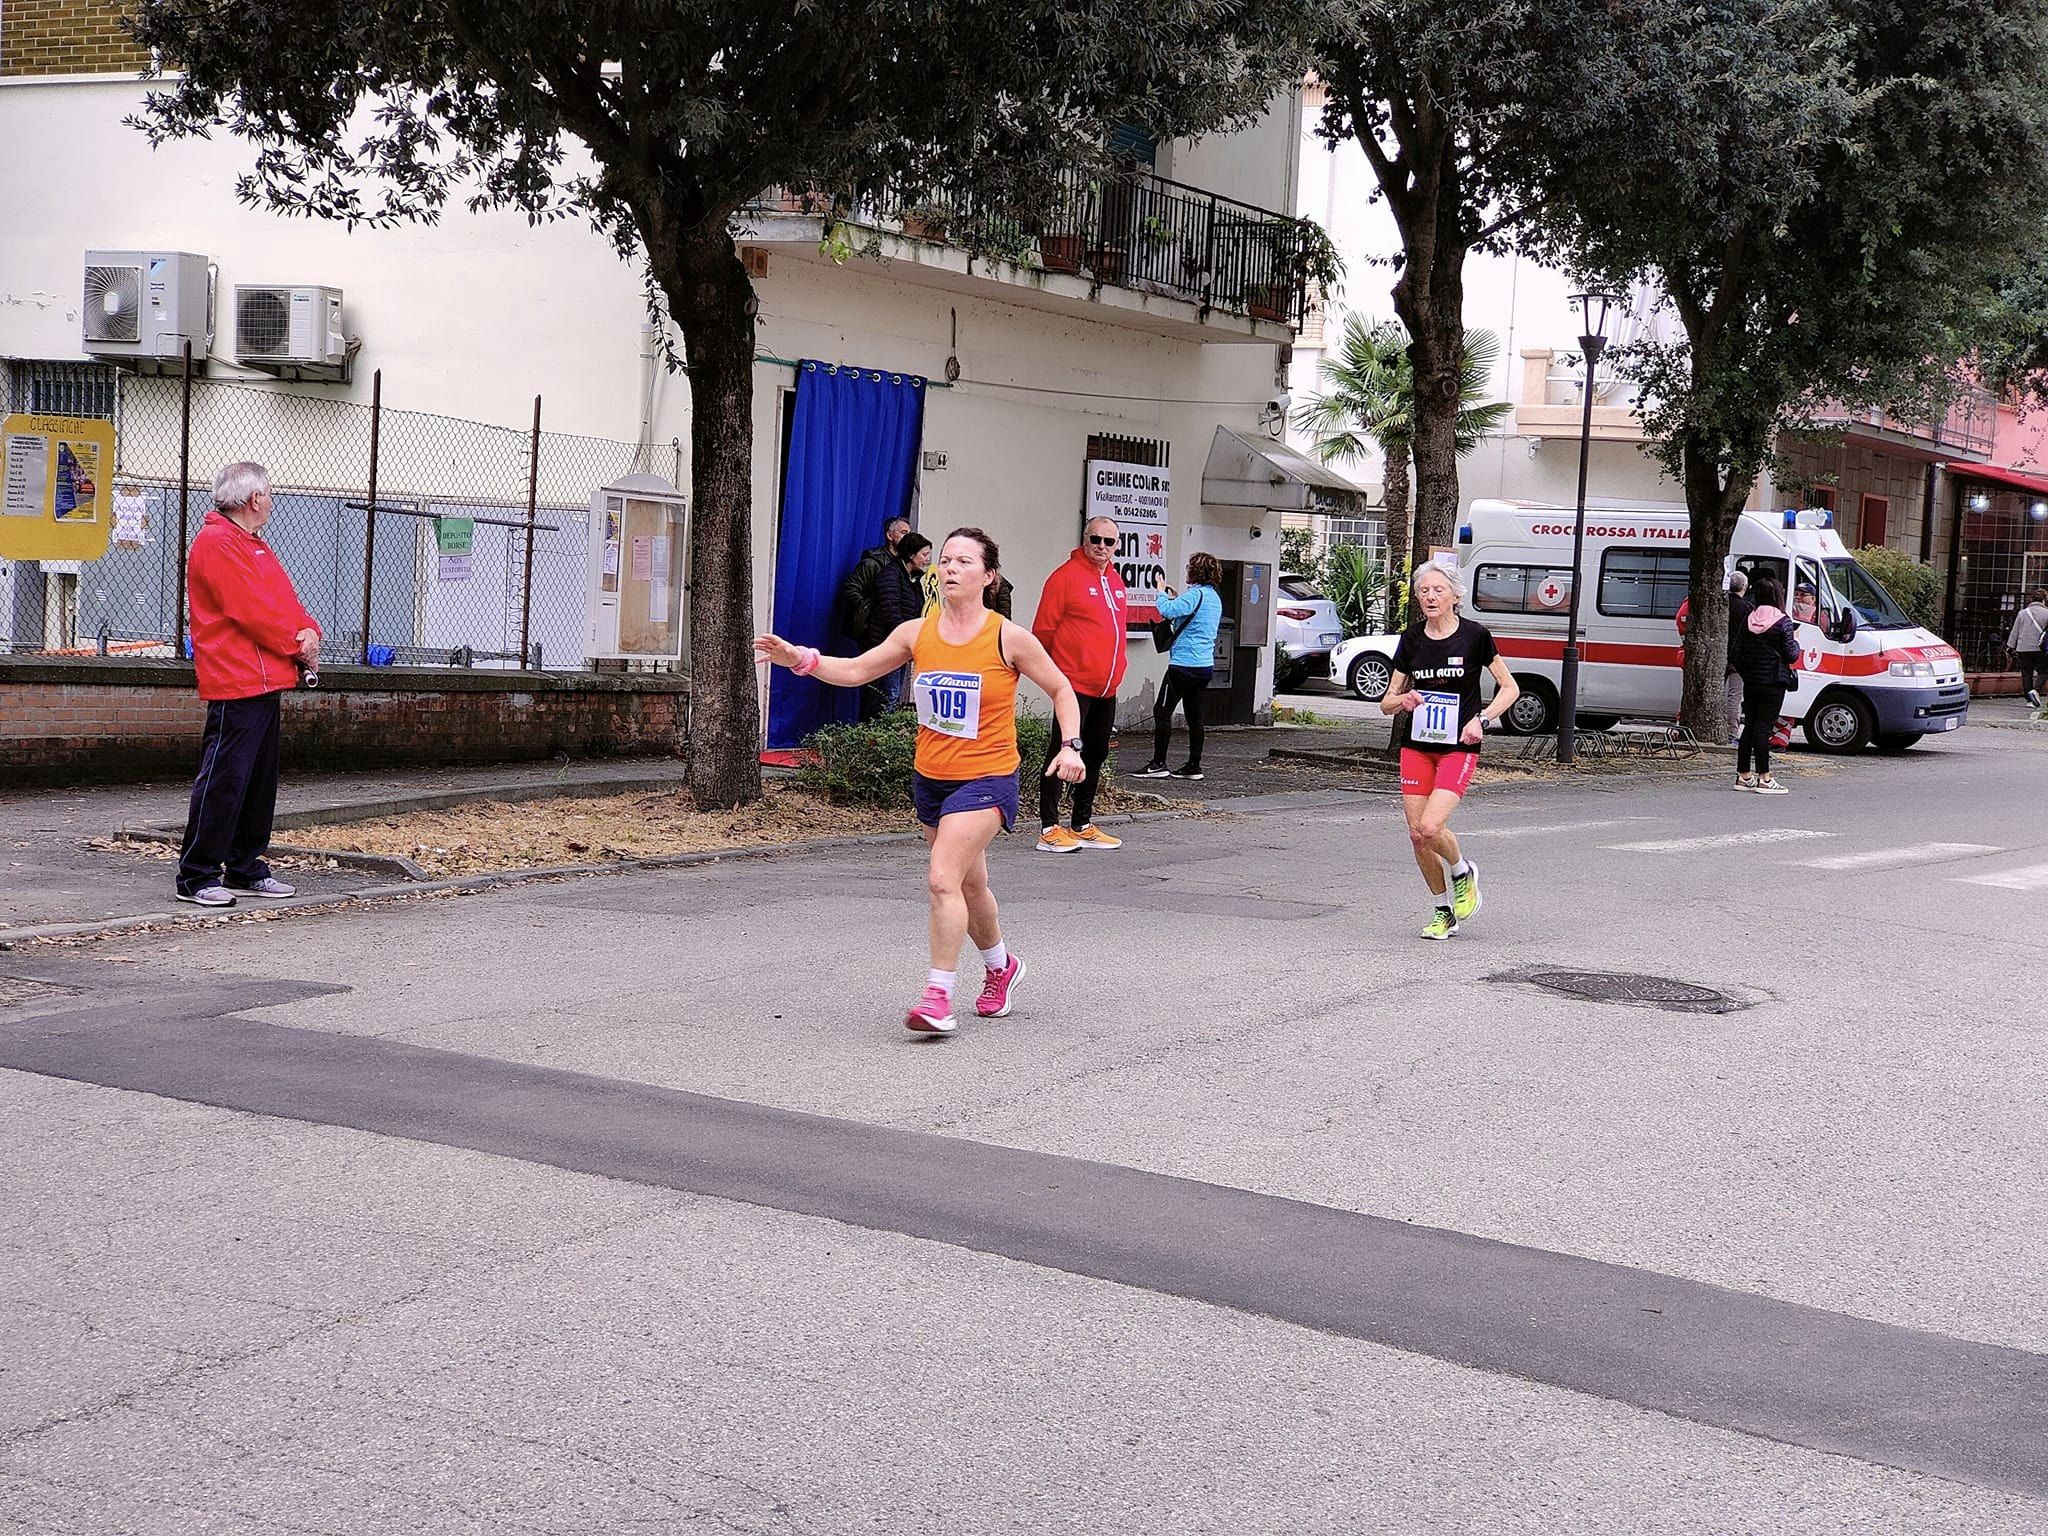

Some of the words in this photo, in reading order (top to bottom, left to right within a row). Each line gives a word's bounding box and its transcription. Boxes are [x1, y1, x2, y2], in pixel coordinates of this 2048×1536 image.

[30, 417, 85, 434] CLASSIFICHE
[442, 532, 472, 540] DEPOSITO
[1586, 526, 1637, 538] ROSSA
[1114, 532, 1140, 558] an
[1113, 562, 1166, 590] arco
[1436, 667, 1465, 678] AUTO
[928, 688, 967, 719] 109
[1425, 704, 1447, 731] 111
